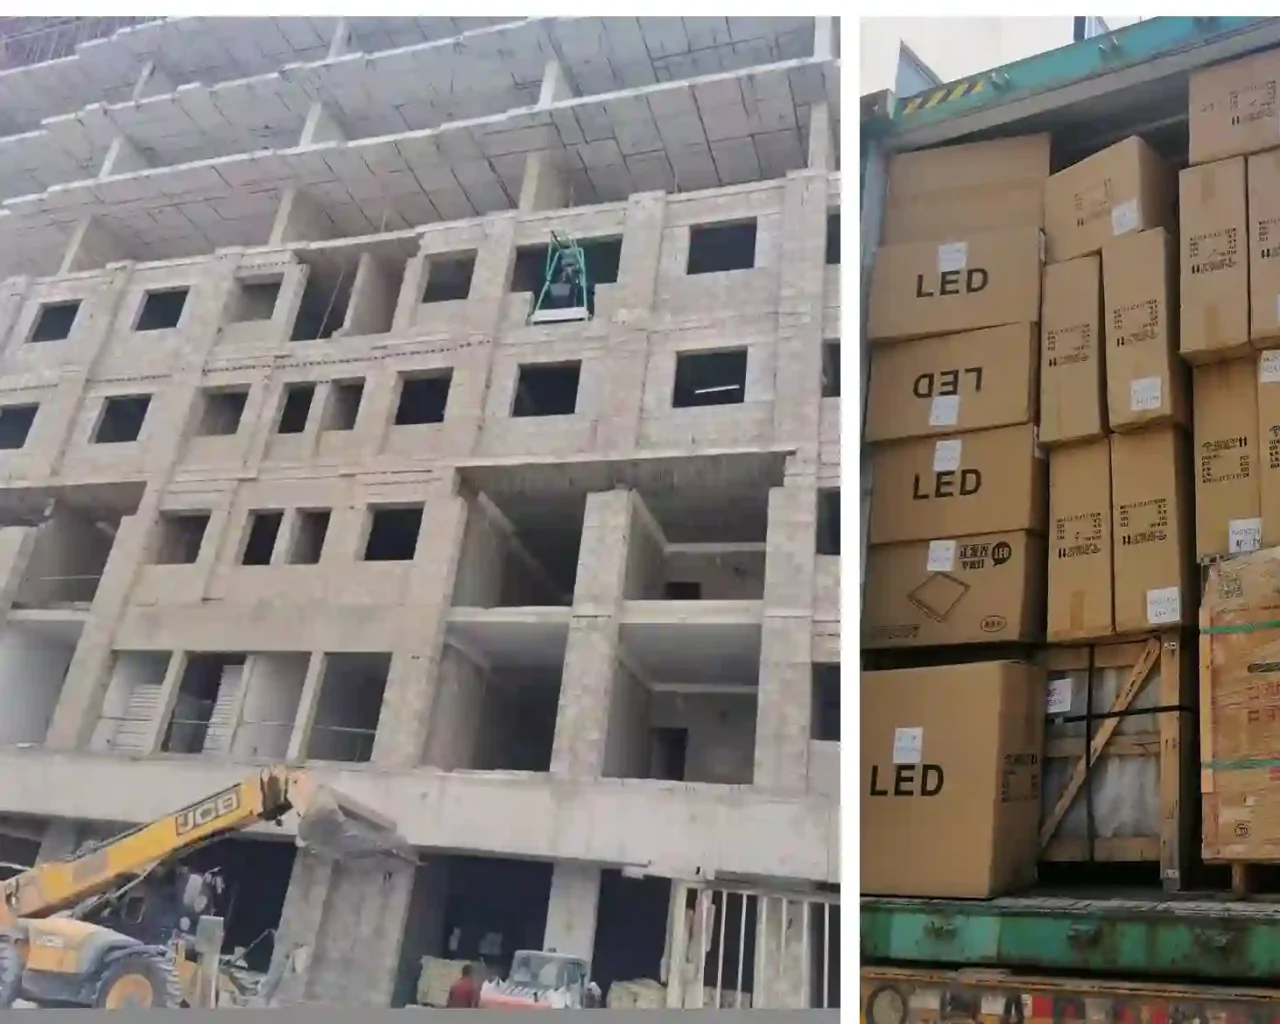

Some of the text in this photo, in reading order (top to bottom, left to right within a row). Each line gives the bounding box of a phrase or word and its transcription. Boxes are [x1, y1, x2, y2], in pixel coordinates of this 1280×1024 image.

[915, 267, 989, 299] LED
[912, 366, 983, 399] LED
[912, 468, 983, 500] LED
[869, 764, 945, 797] LED
[177, 791, 240, 834] JCB
